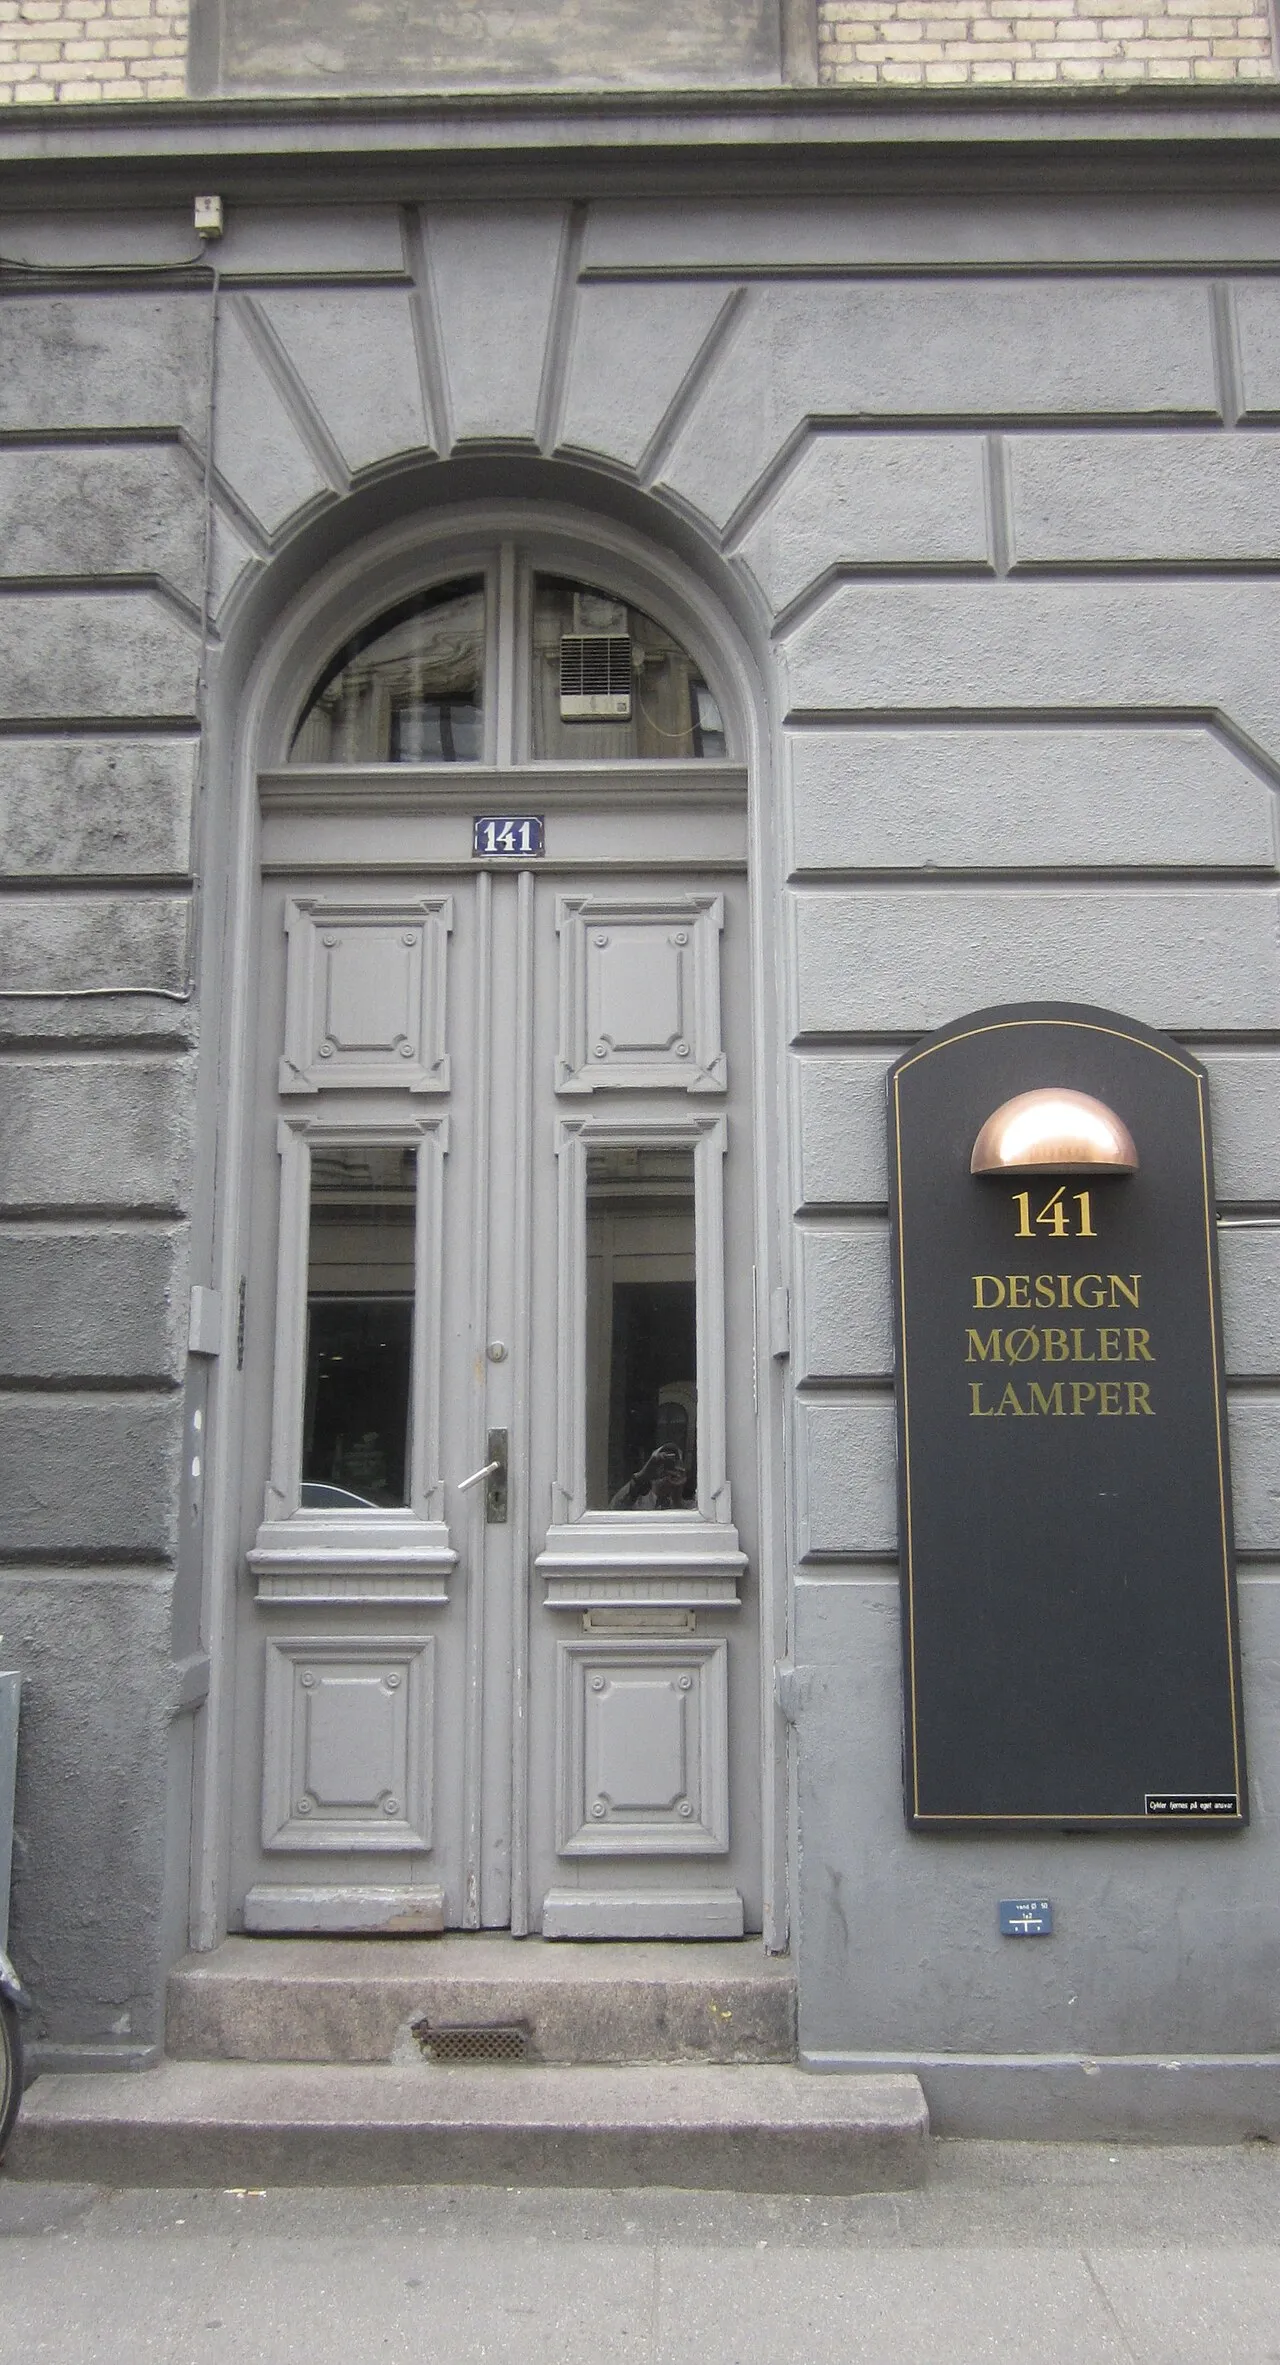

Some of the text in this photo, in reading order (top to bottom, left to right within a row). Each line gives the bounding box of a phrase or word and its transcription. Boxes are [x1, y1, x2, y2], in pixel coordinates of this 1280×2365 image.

[483, 821, 532, 852] 141
[1011, 1186, 1098, 1237] 141
[971, 1274, 1142, 1309] DESIGN
[964, 1325, 1156, 1366] MØBLER
[968, 1382, 1156, 1416] LAMPER
[1149, 1801, 1166, 1810] Cykler
[1169, 1801, 1188, 1810] fjernes
[1189, 1801, 1198, 1810] på
[1199, 1802, 1212, 1810] eget
